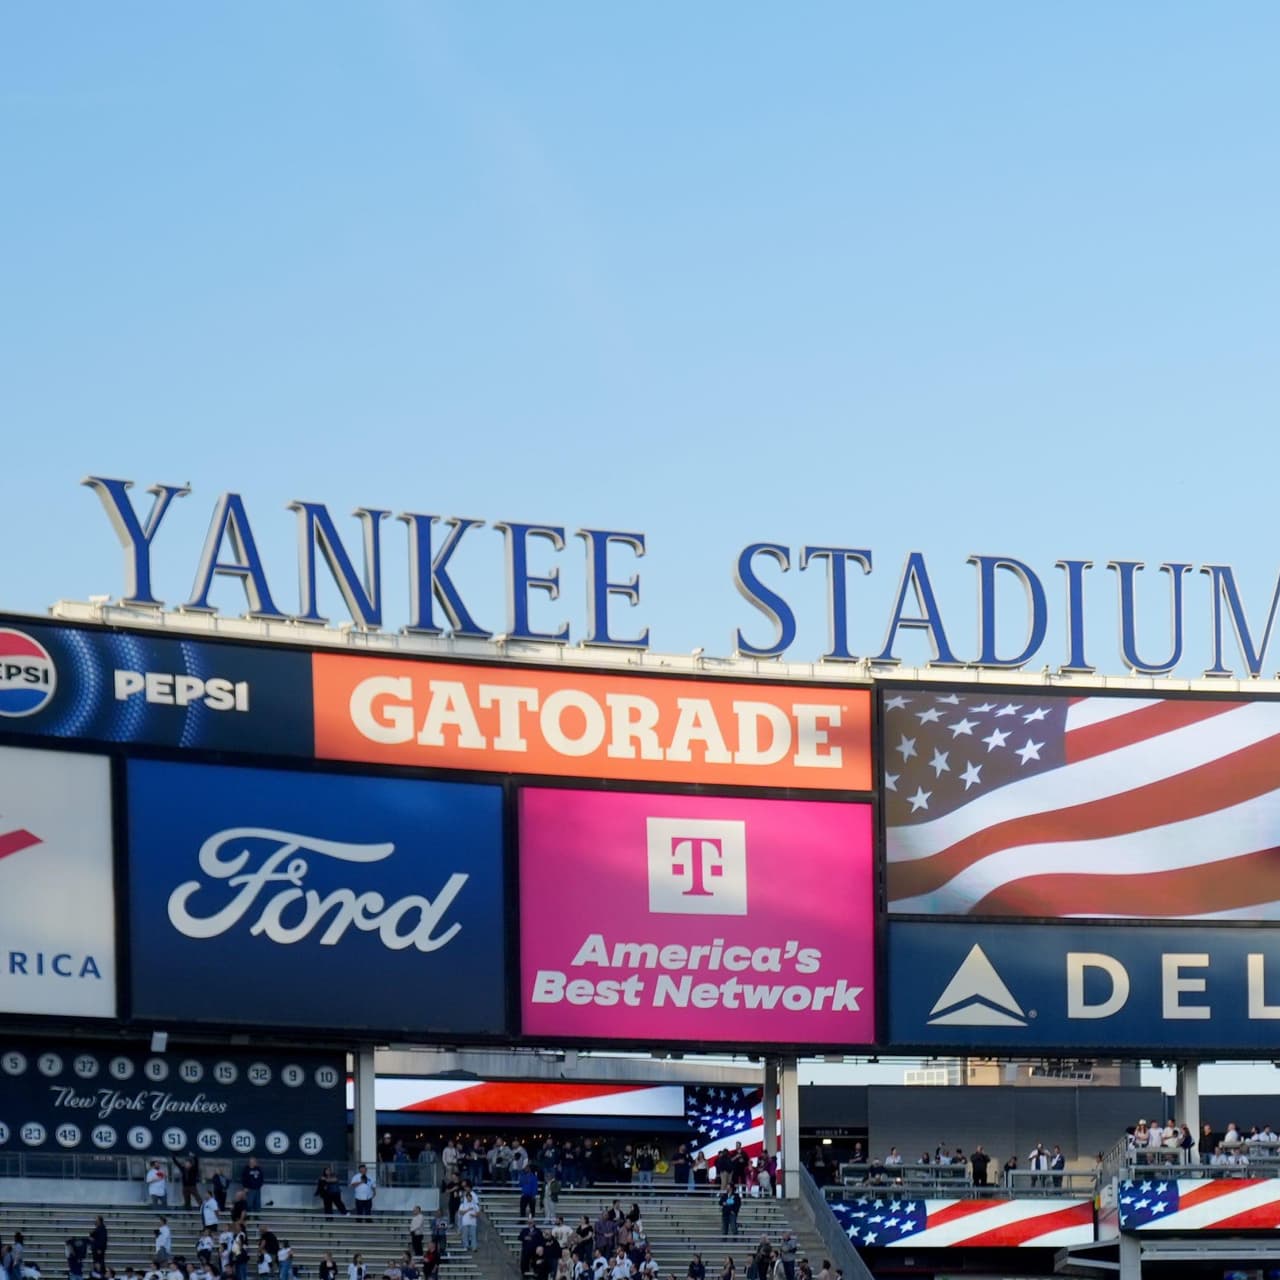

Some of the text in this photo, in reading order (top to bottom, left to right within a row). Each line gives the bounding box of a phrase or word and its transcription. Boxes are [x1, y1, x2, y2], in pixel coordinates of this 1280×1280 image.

[81, 476, 650, 649] YANKEE
[0, 663, 49, 684] PSI
[114, 669, 249, 712] PEPSI
[349, 676, 842, 769] GATORADE
[167, 826, 470, 952] Ford
[9, 951, 102, 979] RICA
[571, 934, 821, 974] America's
[531, 971, 863, 1012] Best Network
[10, 1057, 18, 1069] 5
[78, 1060, 95, 1073] 37
[153, 1062, 161, 1076] 8
[183, 1064, 199, 1078] 16
[218, 1065, 233, 1079] 15
[252, 1067, 268, 1081] 32
[288, 1069, 297, 1082] 9
[319, 1070, 333, 1084] 10
[50, 1085, 227, 1121] New York Yankees
[24, 1127, 319, 1150] 23 49 42 6 51 46 20 2 21
